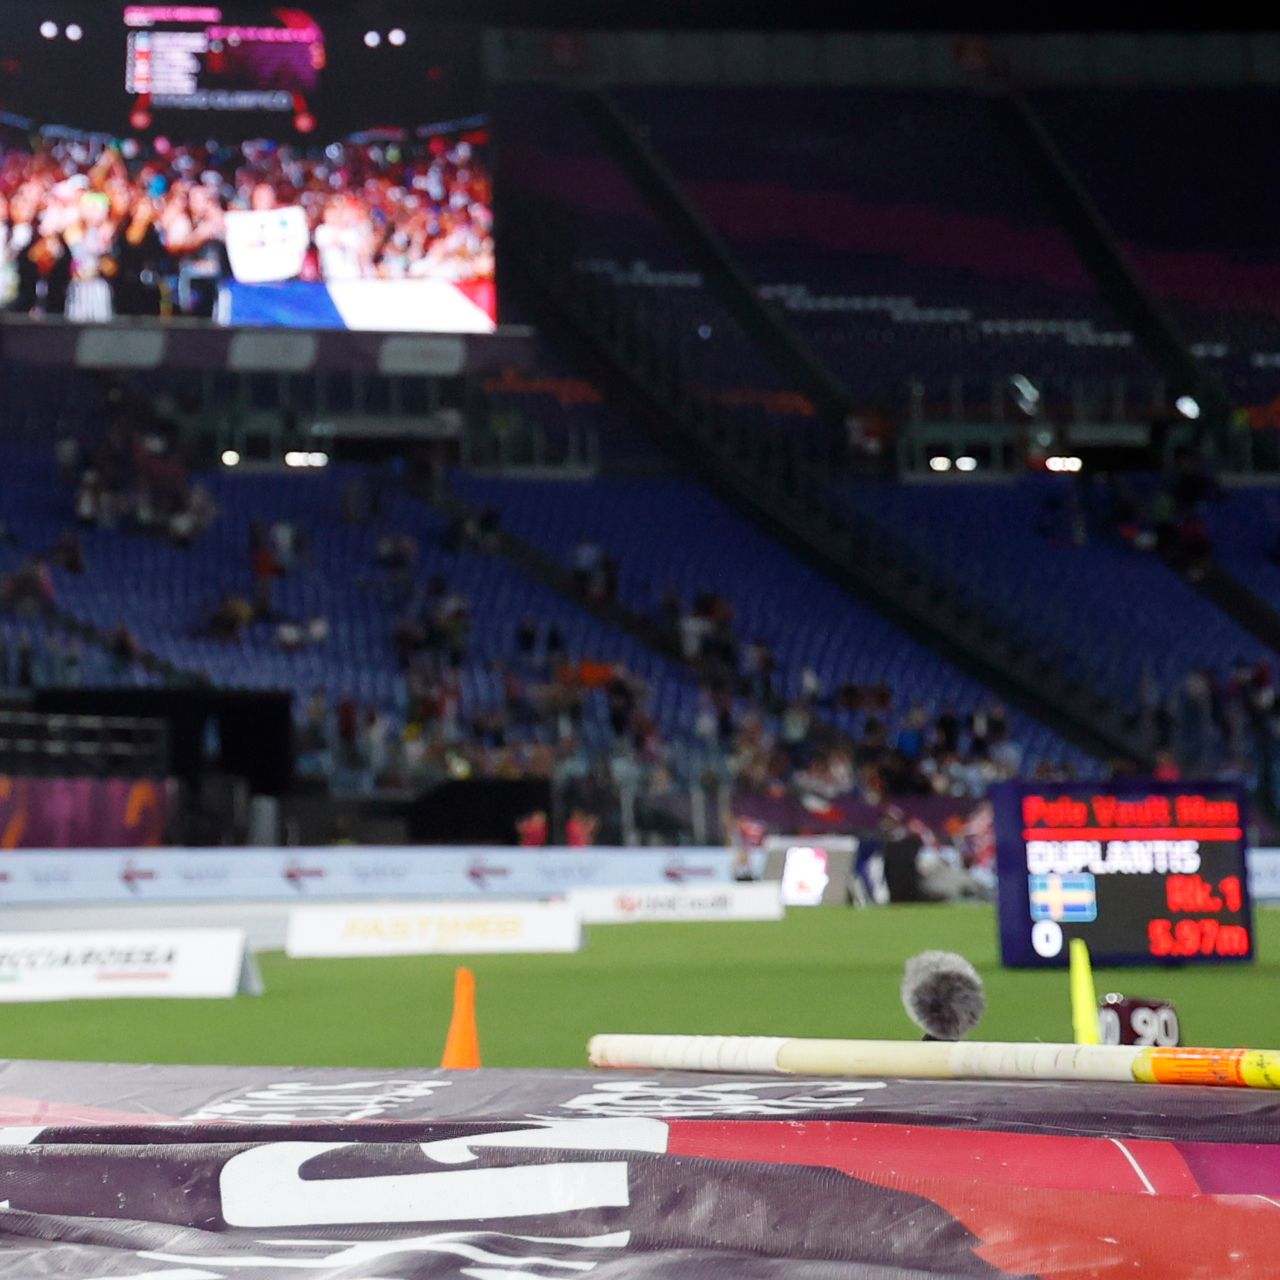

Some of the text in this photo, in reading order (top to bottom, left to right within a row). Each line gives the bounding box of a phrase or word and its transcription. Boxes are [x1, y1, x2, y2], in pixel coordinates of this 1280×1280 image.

[1022, 795, 1088, 827] Pole
[1091, 795, 1171, 827] Vault
[1026, 840, 1201, 874] DUPLANTIS
[1219, 876, 1242, 913] 1
[1032, 920, 1063, 958] 0
[1148, 919, 1250, 956] 5.97m
